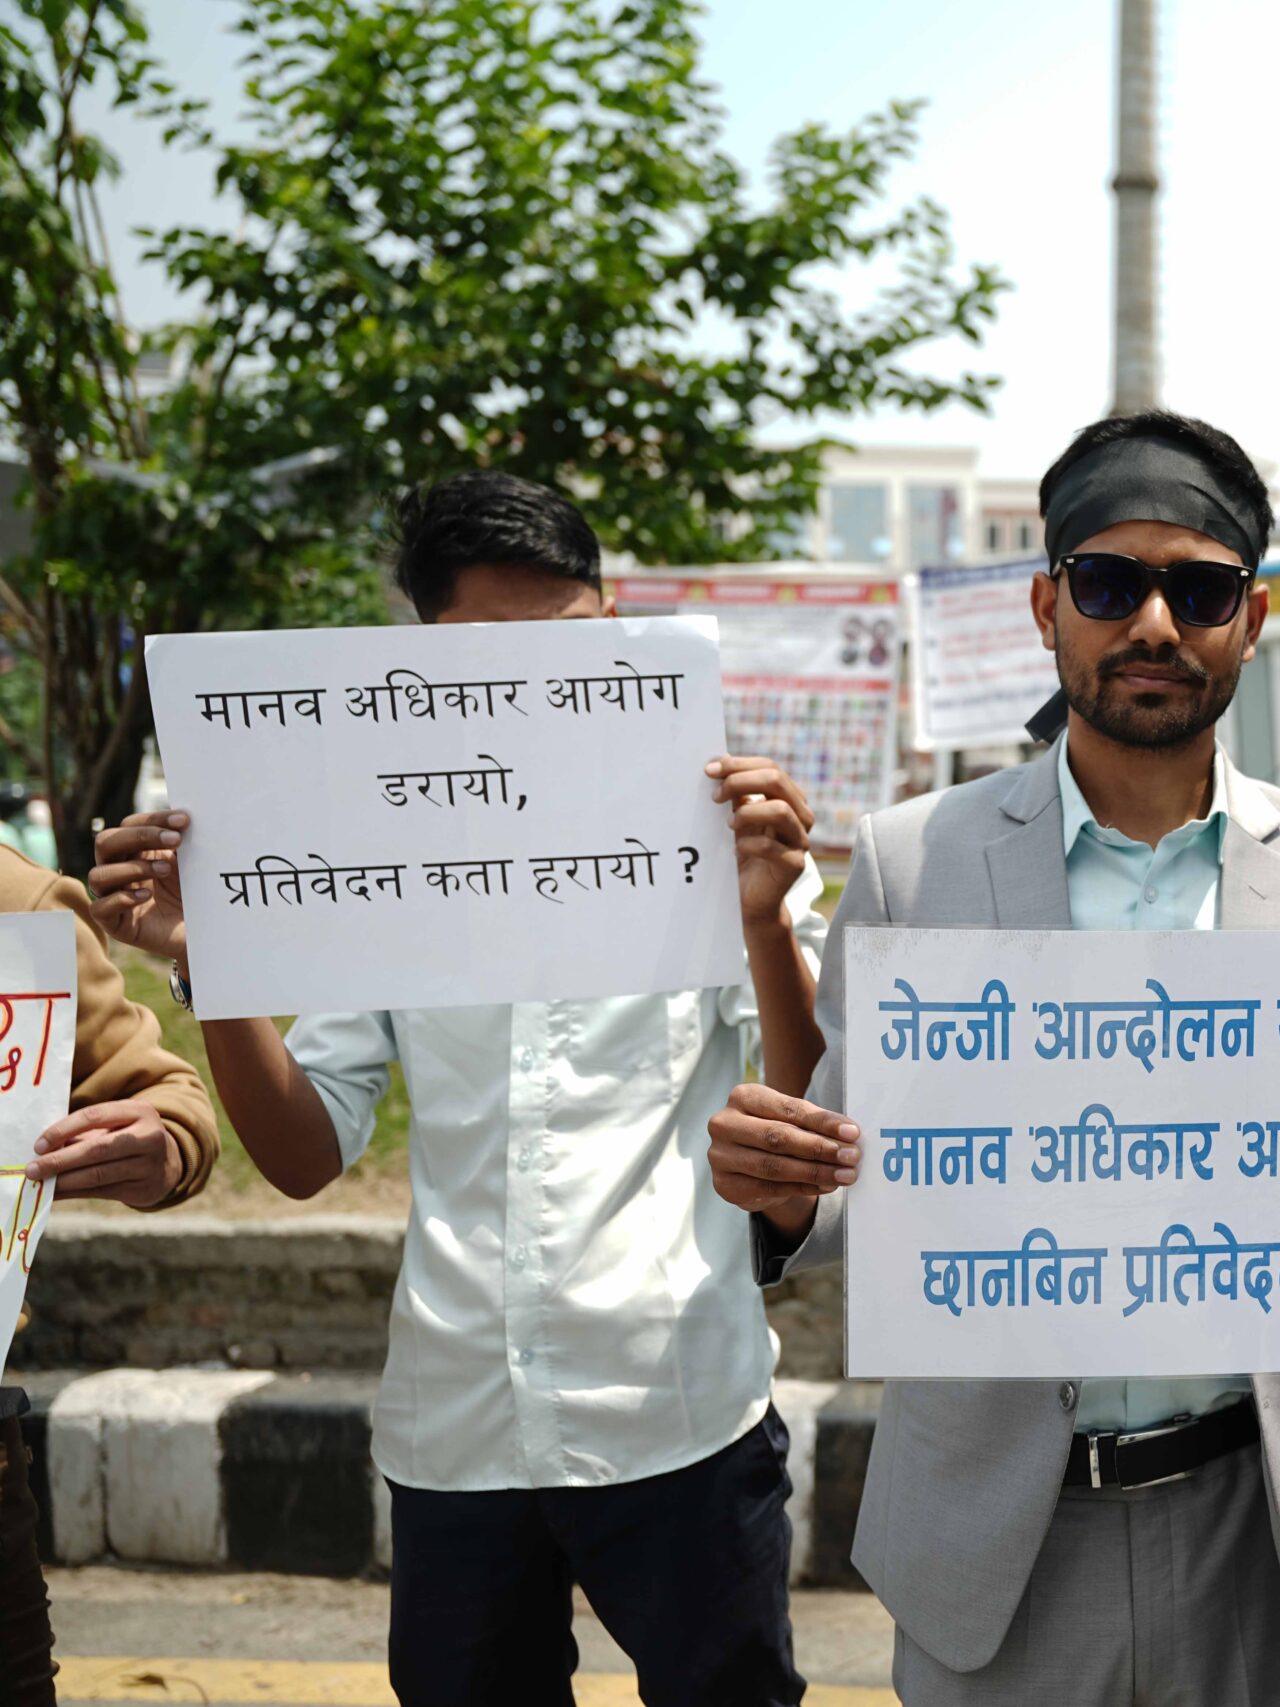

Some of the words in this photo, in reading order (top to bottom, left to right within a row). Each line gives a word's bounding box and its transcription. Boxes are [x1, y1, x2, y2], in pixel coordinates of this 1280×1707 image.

[194, 688, 327, 730] मानव
[345, 669, 528, 723] अधिकार
[546, 660, 684, 713] आयोग
[376, 754, 528, 811] डरायो,
[219, 854, 407, 908] प्रतिवेदन
[422, 859, 514, 897] कता
[528, 838, 660, 904] हरायो
[677, 846, 700, 884] ?
[878, 978, 1016, 1061] जेन्जी
[1032, 978, 1262, 1073] आन्दोलन
[879, 1126, 1013, 1186] मानव
[1029, 1103, 1221, 1183] अधिकार
[920, 1227, 1108, 1317] छानबिन
